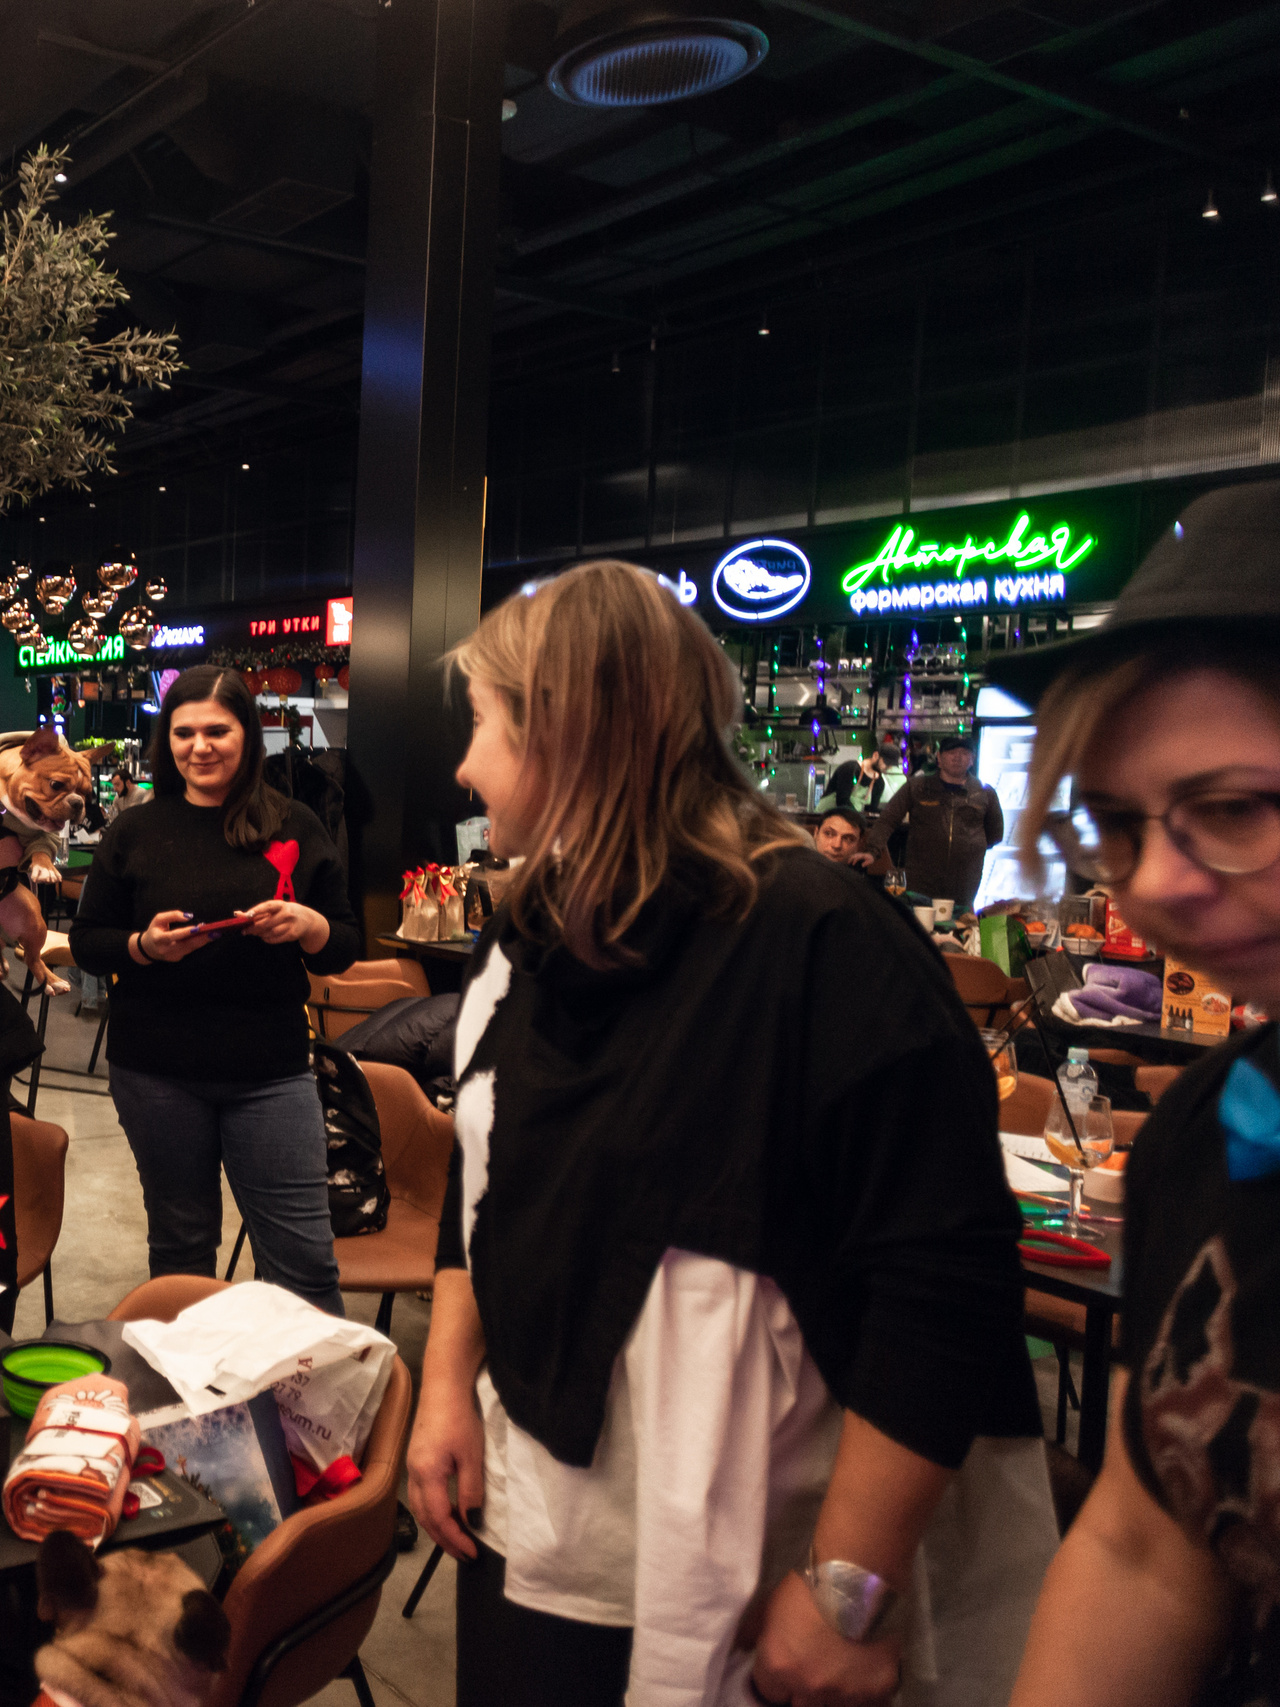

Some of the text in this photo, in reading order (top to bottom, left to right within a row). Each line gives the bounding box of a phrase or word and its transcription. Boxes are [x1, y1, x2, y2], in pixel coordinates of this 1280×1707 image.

[841, 512, 1093, 592] Авторская
[850, 572, 1066, 614] фермерская кухня
[250, 615, 320, 636] ТРИ УТКИ
